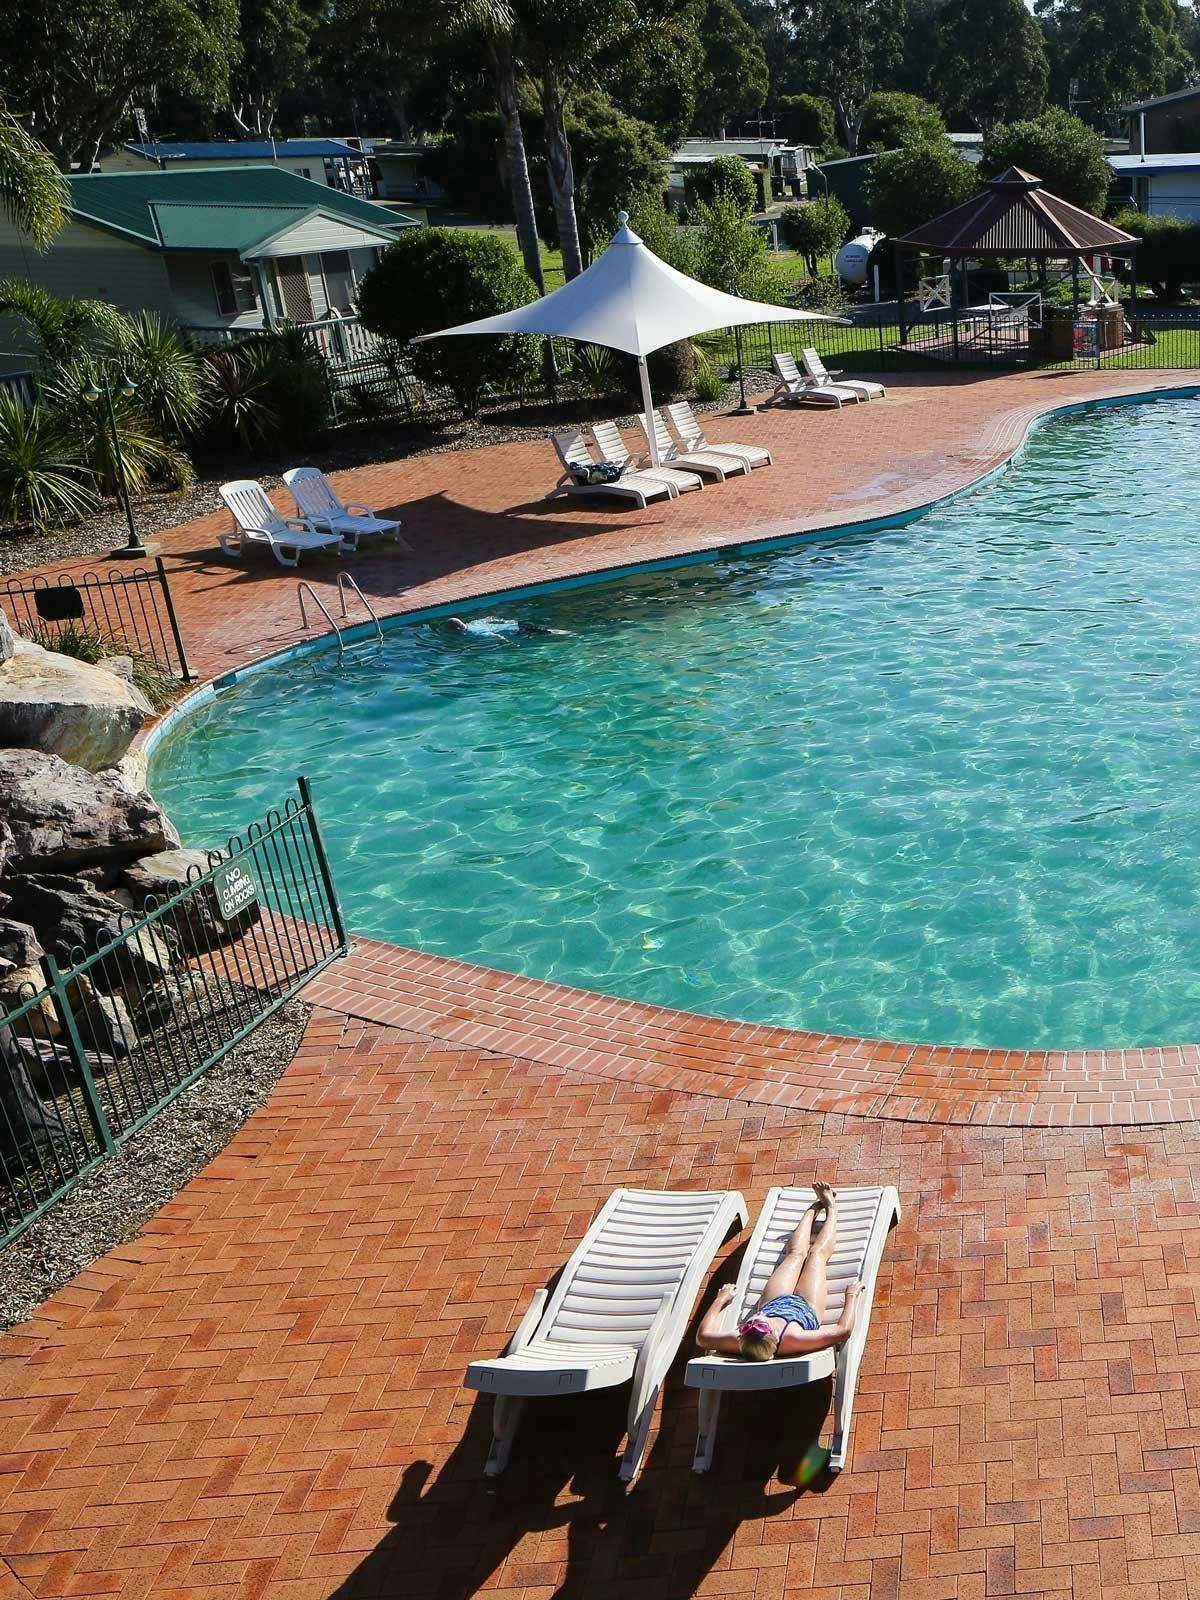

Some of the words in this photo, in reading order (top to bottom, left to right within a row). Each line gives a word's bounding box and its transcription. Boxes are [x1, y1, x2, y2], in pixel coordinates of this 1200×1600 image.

[223, 874, 251, 900] CLIMBING
[225, 867, 241, 885] NO
[224, 898, 235, 913] ON
[234, 884, 255, 906] ROCKS
